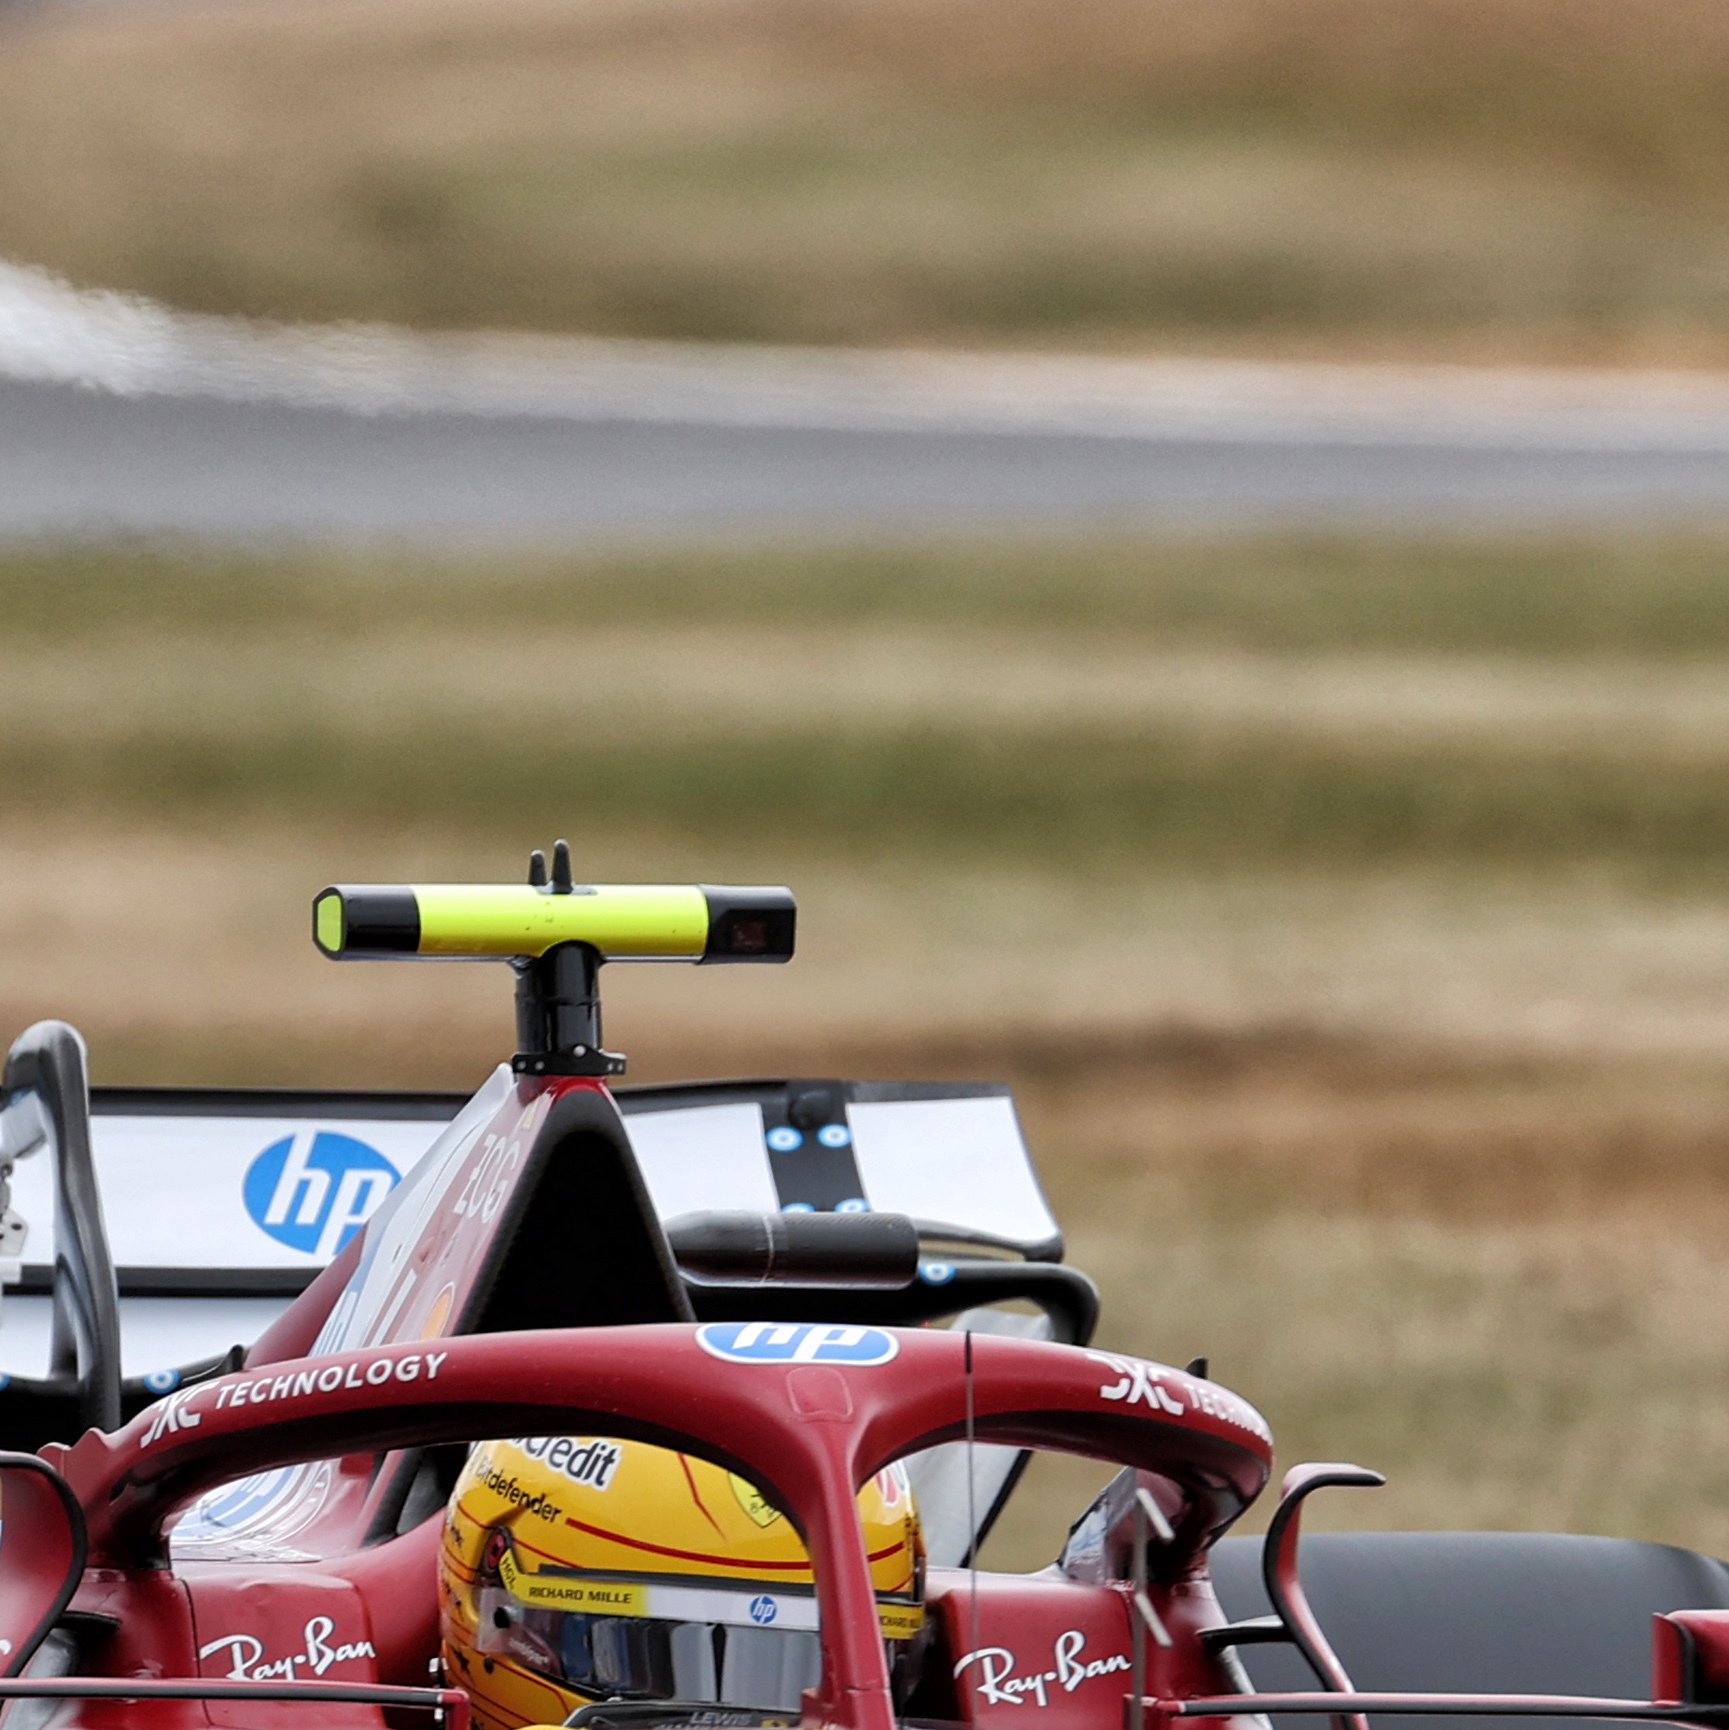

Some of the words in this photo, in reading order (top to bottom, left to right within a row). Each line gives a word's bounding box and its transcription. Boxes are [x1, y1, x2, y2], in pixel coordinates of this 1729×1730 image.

[264, 1130, 384, 1256] hp
[214, 1351, 448, 1411] TECHNOLOGY
[528, 1586, 584, 1601] RICHARD
[588, 1590, 633, 1604] MILLE
[752, 1595, 777, 1624] hp
[199, 1616, 376, 1682] Ray-Ban
[953, 1630, 1132, 1706] Ray-Ban
